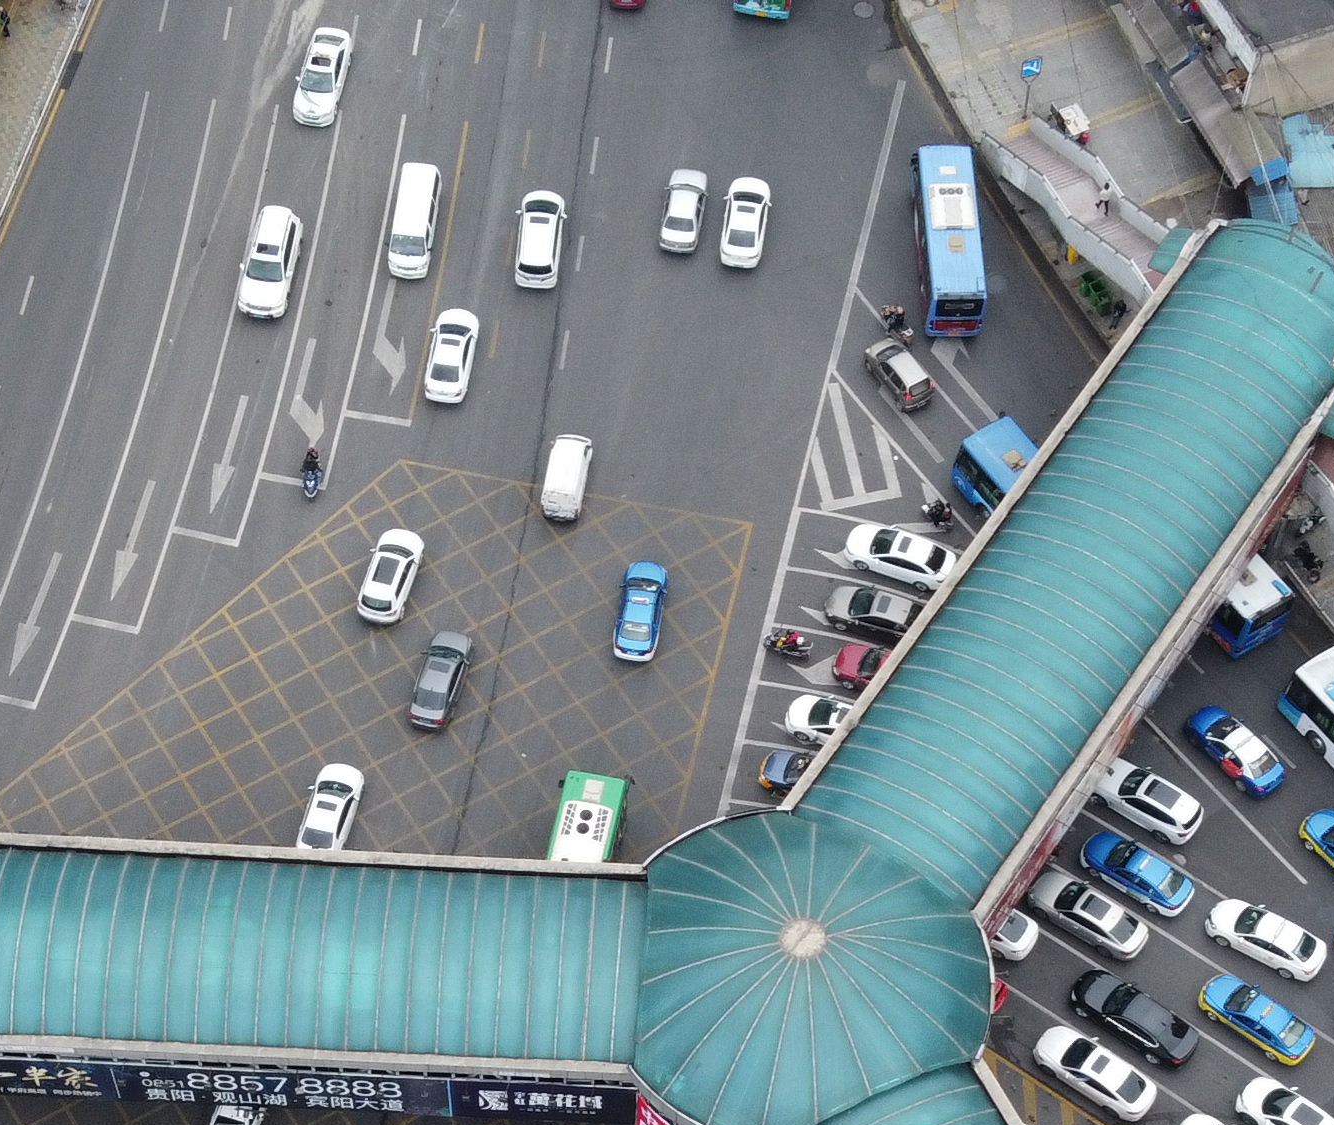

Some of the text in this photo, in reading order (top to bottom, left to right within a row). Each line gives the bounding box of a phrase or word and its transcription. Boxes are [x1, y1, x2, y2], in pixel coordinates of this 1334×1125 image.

[141, 1072, 403, 1099] 0851 8857 8888
